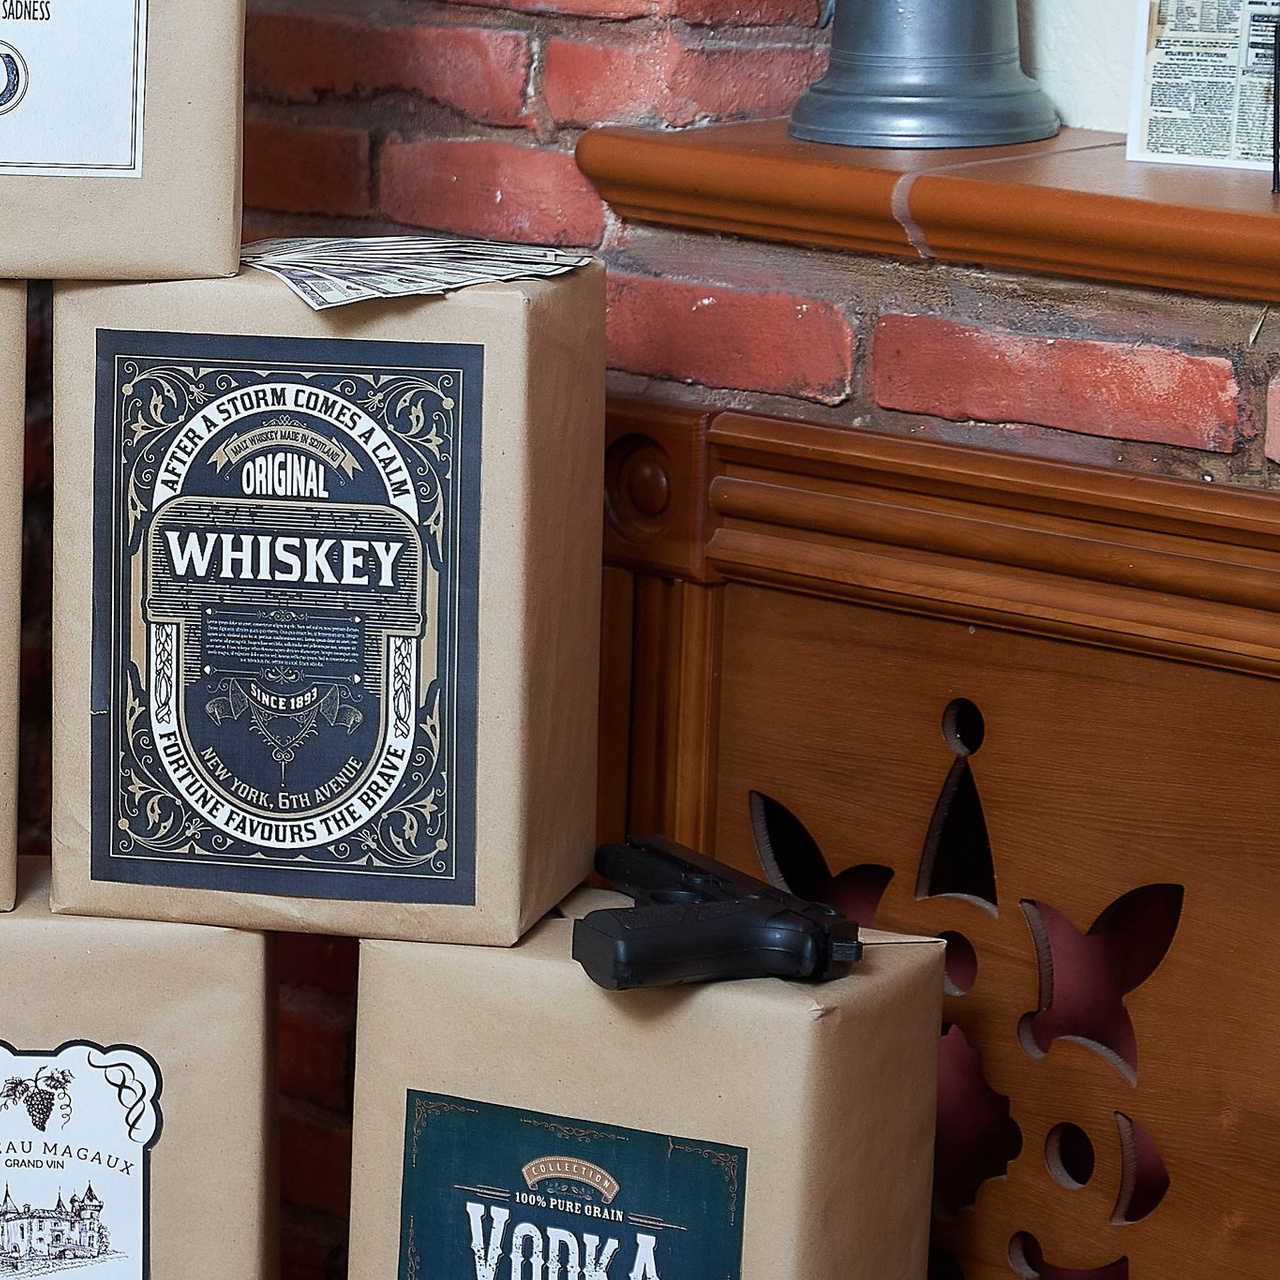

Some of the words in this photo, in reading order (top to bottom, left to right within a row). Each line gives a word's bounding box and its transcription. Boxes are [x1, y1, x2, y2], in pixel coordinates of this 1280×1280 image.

[2, 0, 51, 21] SADNESS
[161, 429, 203, 493] AFTER
[205, 415, 217, 432] A
[222, 387, 287, 423] STORM
[294, 389, 358, 431] COMES
[358, 428, 373, 446] A
[372, 440, 411, 500] CALM
[230, 441, 249, 456] MALT
[248, 431, 279, 445] WHISKEY
[280, 431, 299, 440] MADE
[301, 433, 309, 443] IN
[309, 437, 340, 461] SCOTLAND
[242, 453, 329, 498] ORIGINAL
[165, 531, 403, 587] WHISKEY
[250, 683, 287, 709] SINCE
[290, 687, 318, 710] 1893
[159, 730, 223, 821] FORTUNE
[224, 812, 317, 843] FAVOURS
[320, 807, 361, 836] THE
[362, 744, 405, 814] BRAVE
[200, 746, 230, 782] NEW
[230, 779, 274, 810] YORK,
[279, 791, 312, 810] 6TH
[316, 755, 363, 806] AVENUE
[5, 1158, 44, 1169] GRAND
[46, 1159, 65, 1169] VIN
[43, 1142, 135, 1176] MAGAUX
[531, 1162, 612, 1190] COLLECTION
[515, 1191, 547, 1208] 100%
[549, 1197, 582, 1215] PURE
[585, 1203, 624, 1222] GRAIN
